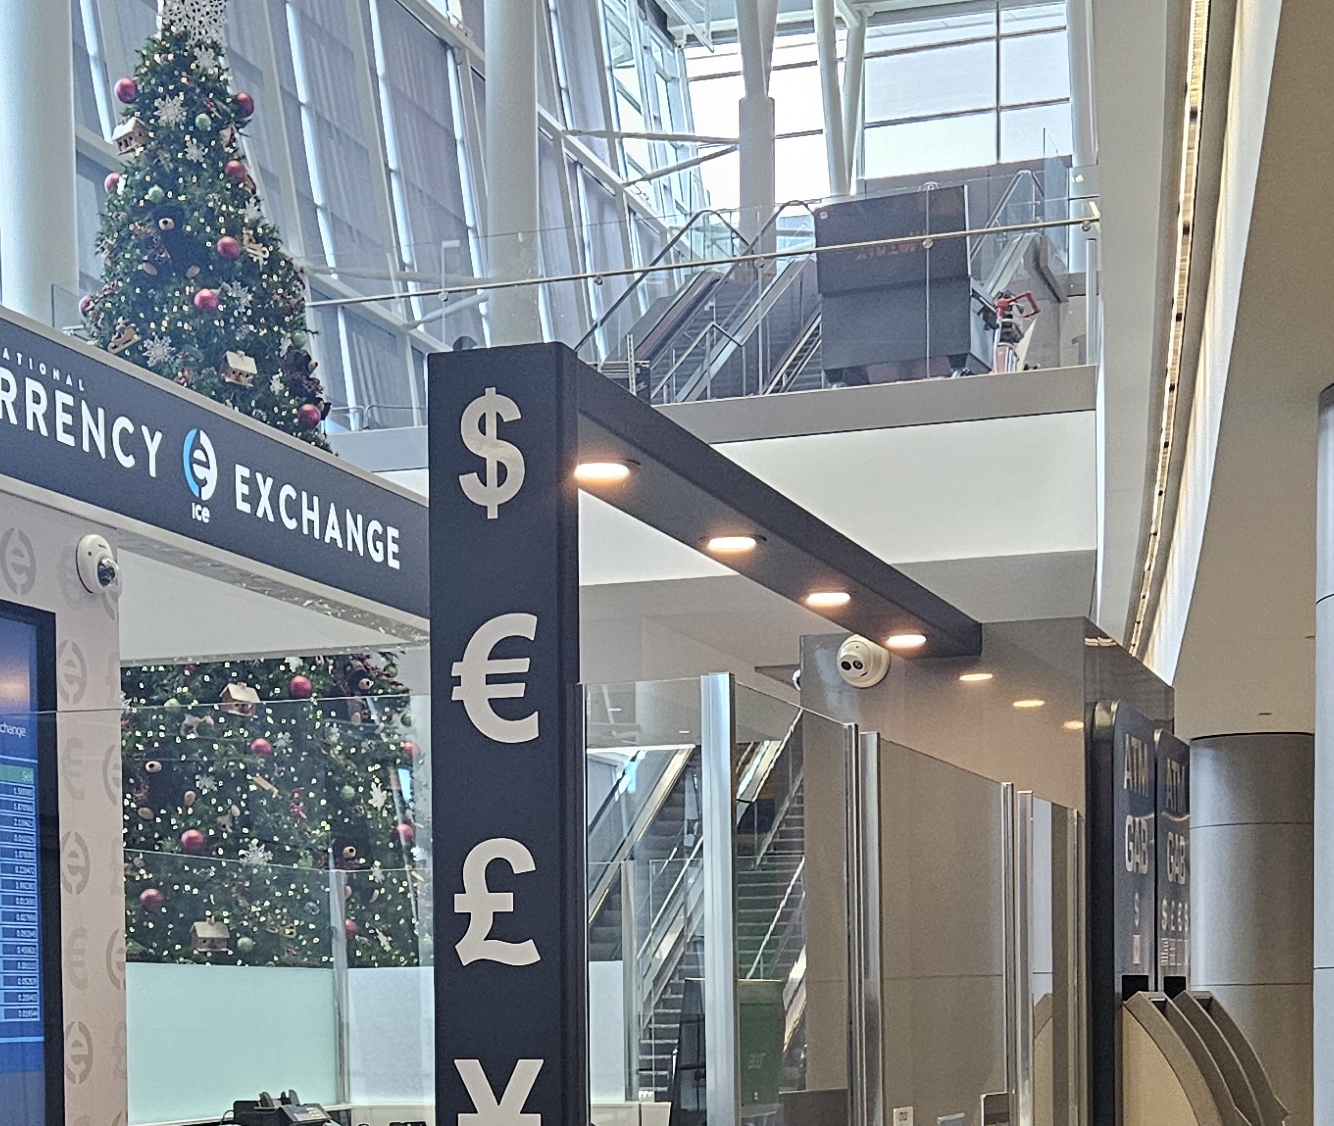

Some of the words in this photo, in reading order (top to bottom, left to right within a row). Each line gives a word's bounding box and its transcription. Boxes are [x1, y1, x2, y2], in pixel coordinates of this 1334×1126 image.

[458, 387, 527, 520] $
[234, 463, 400, 570] EXCHANGE
[451, 612, 541, 744] €
[1124, 733, 1149, 798] ATM
[1125, 814, 1149, 875] GAB
[1167, 831, 1186, 885] GAB
[454, 838, 541, 966] £
